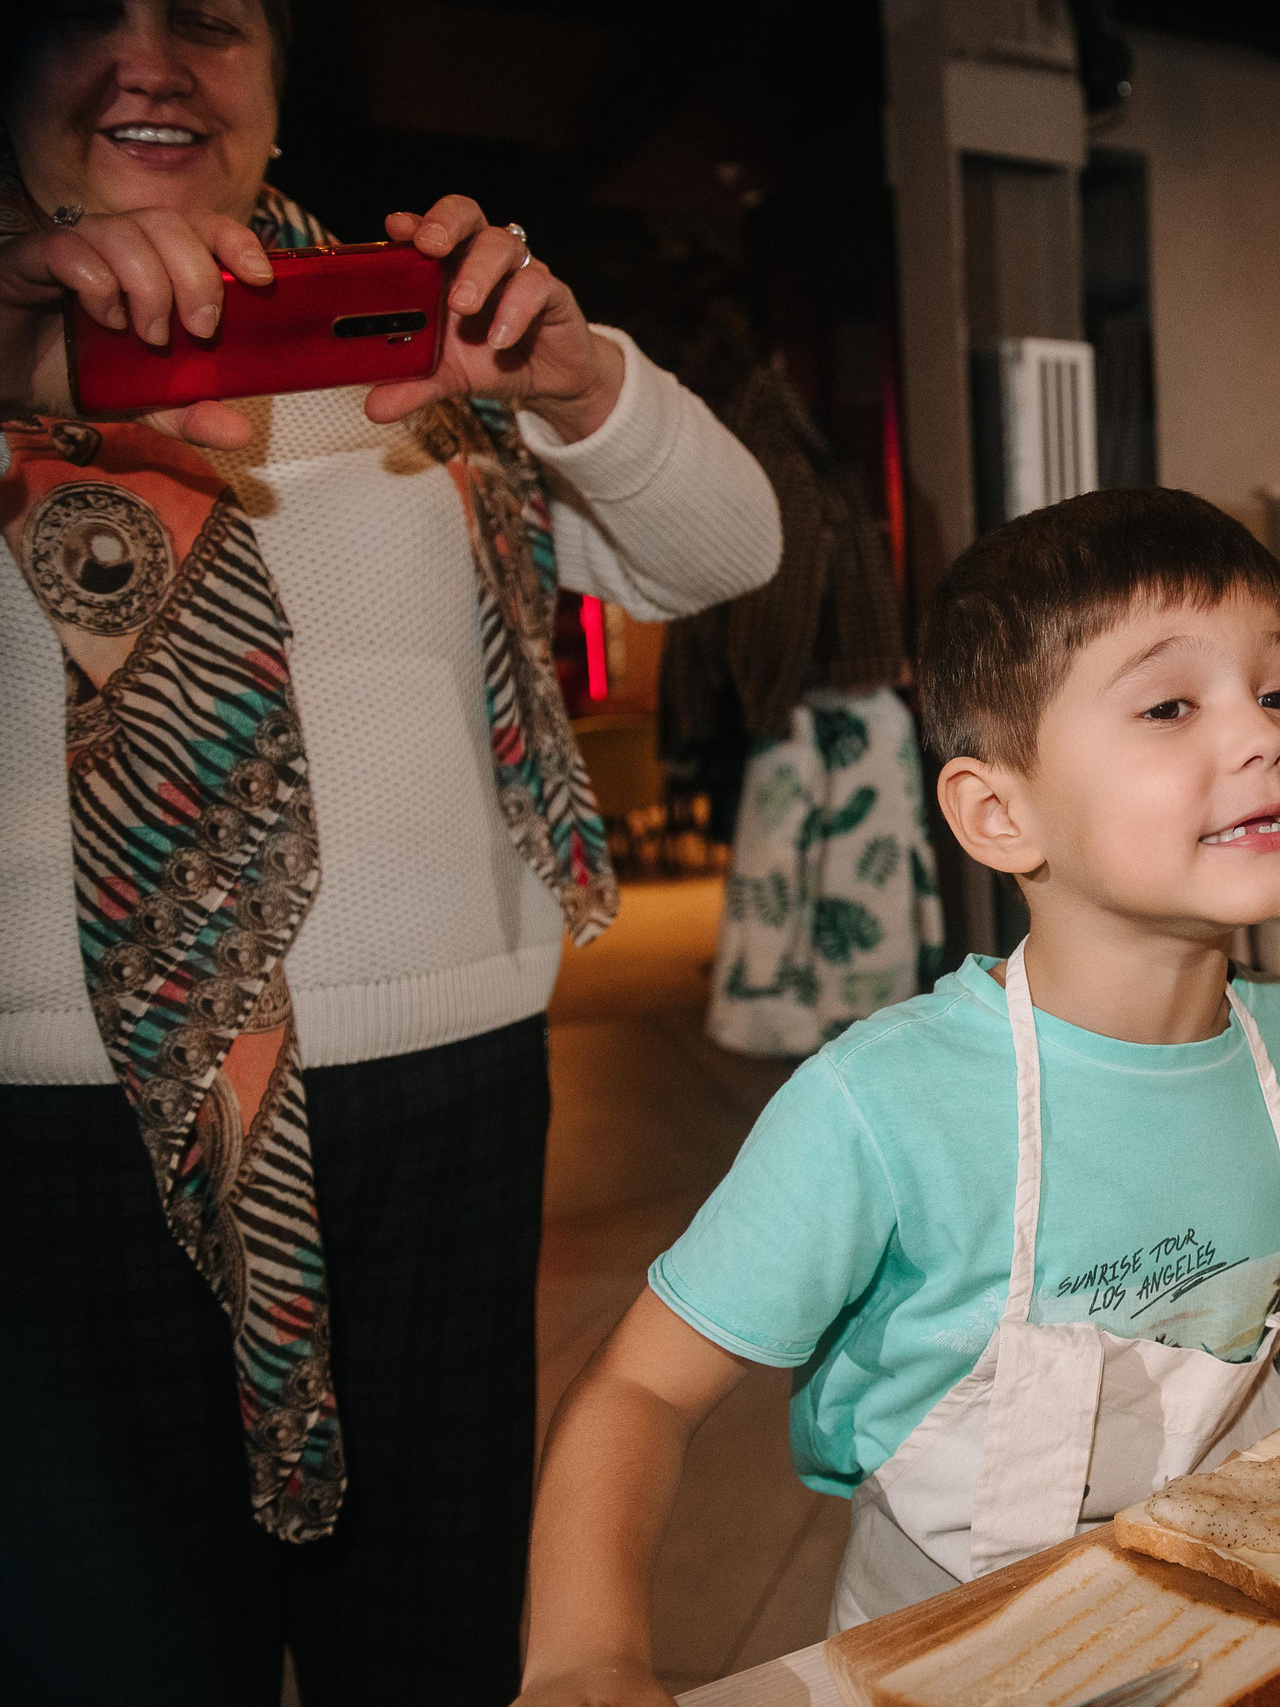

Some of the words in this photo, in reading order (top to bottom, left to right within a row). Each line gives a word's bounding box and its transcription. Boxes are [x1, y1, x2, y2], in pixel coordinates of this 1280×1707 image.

[1056, 1247, 1144, 1298] SUNRISE
[1149, 1228, 1199, 1263] TOUR
[1088, 1284, 1126, 1315] LOS
[1136, 1240, 1216, 1300] ANGELES
